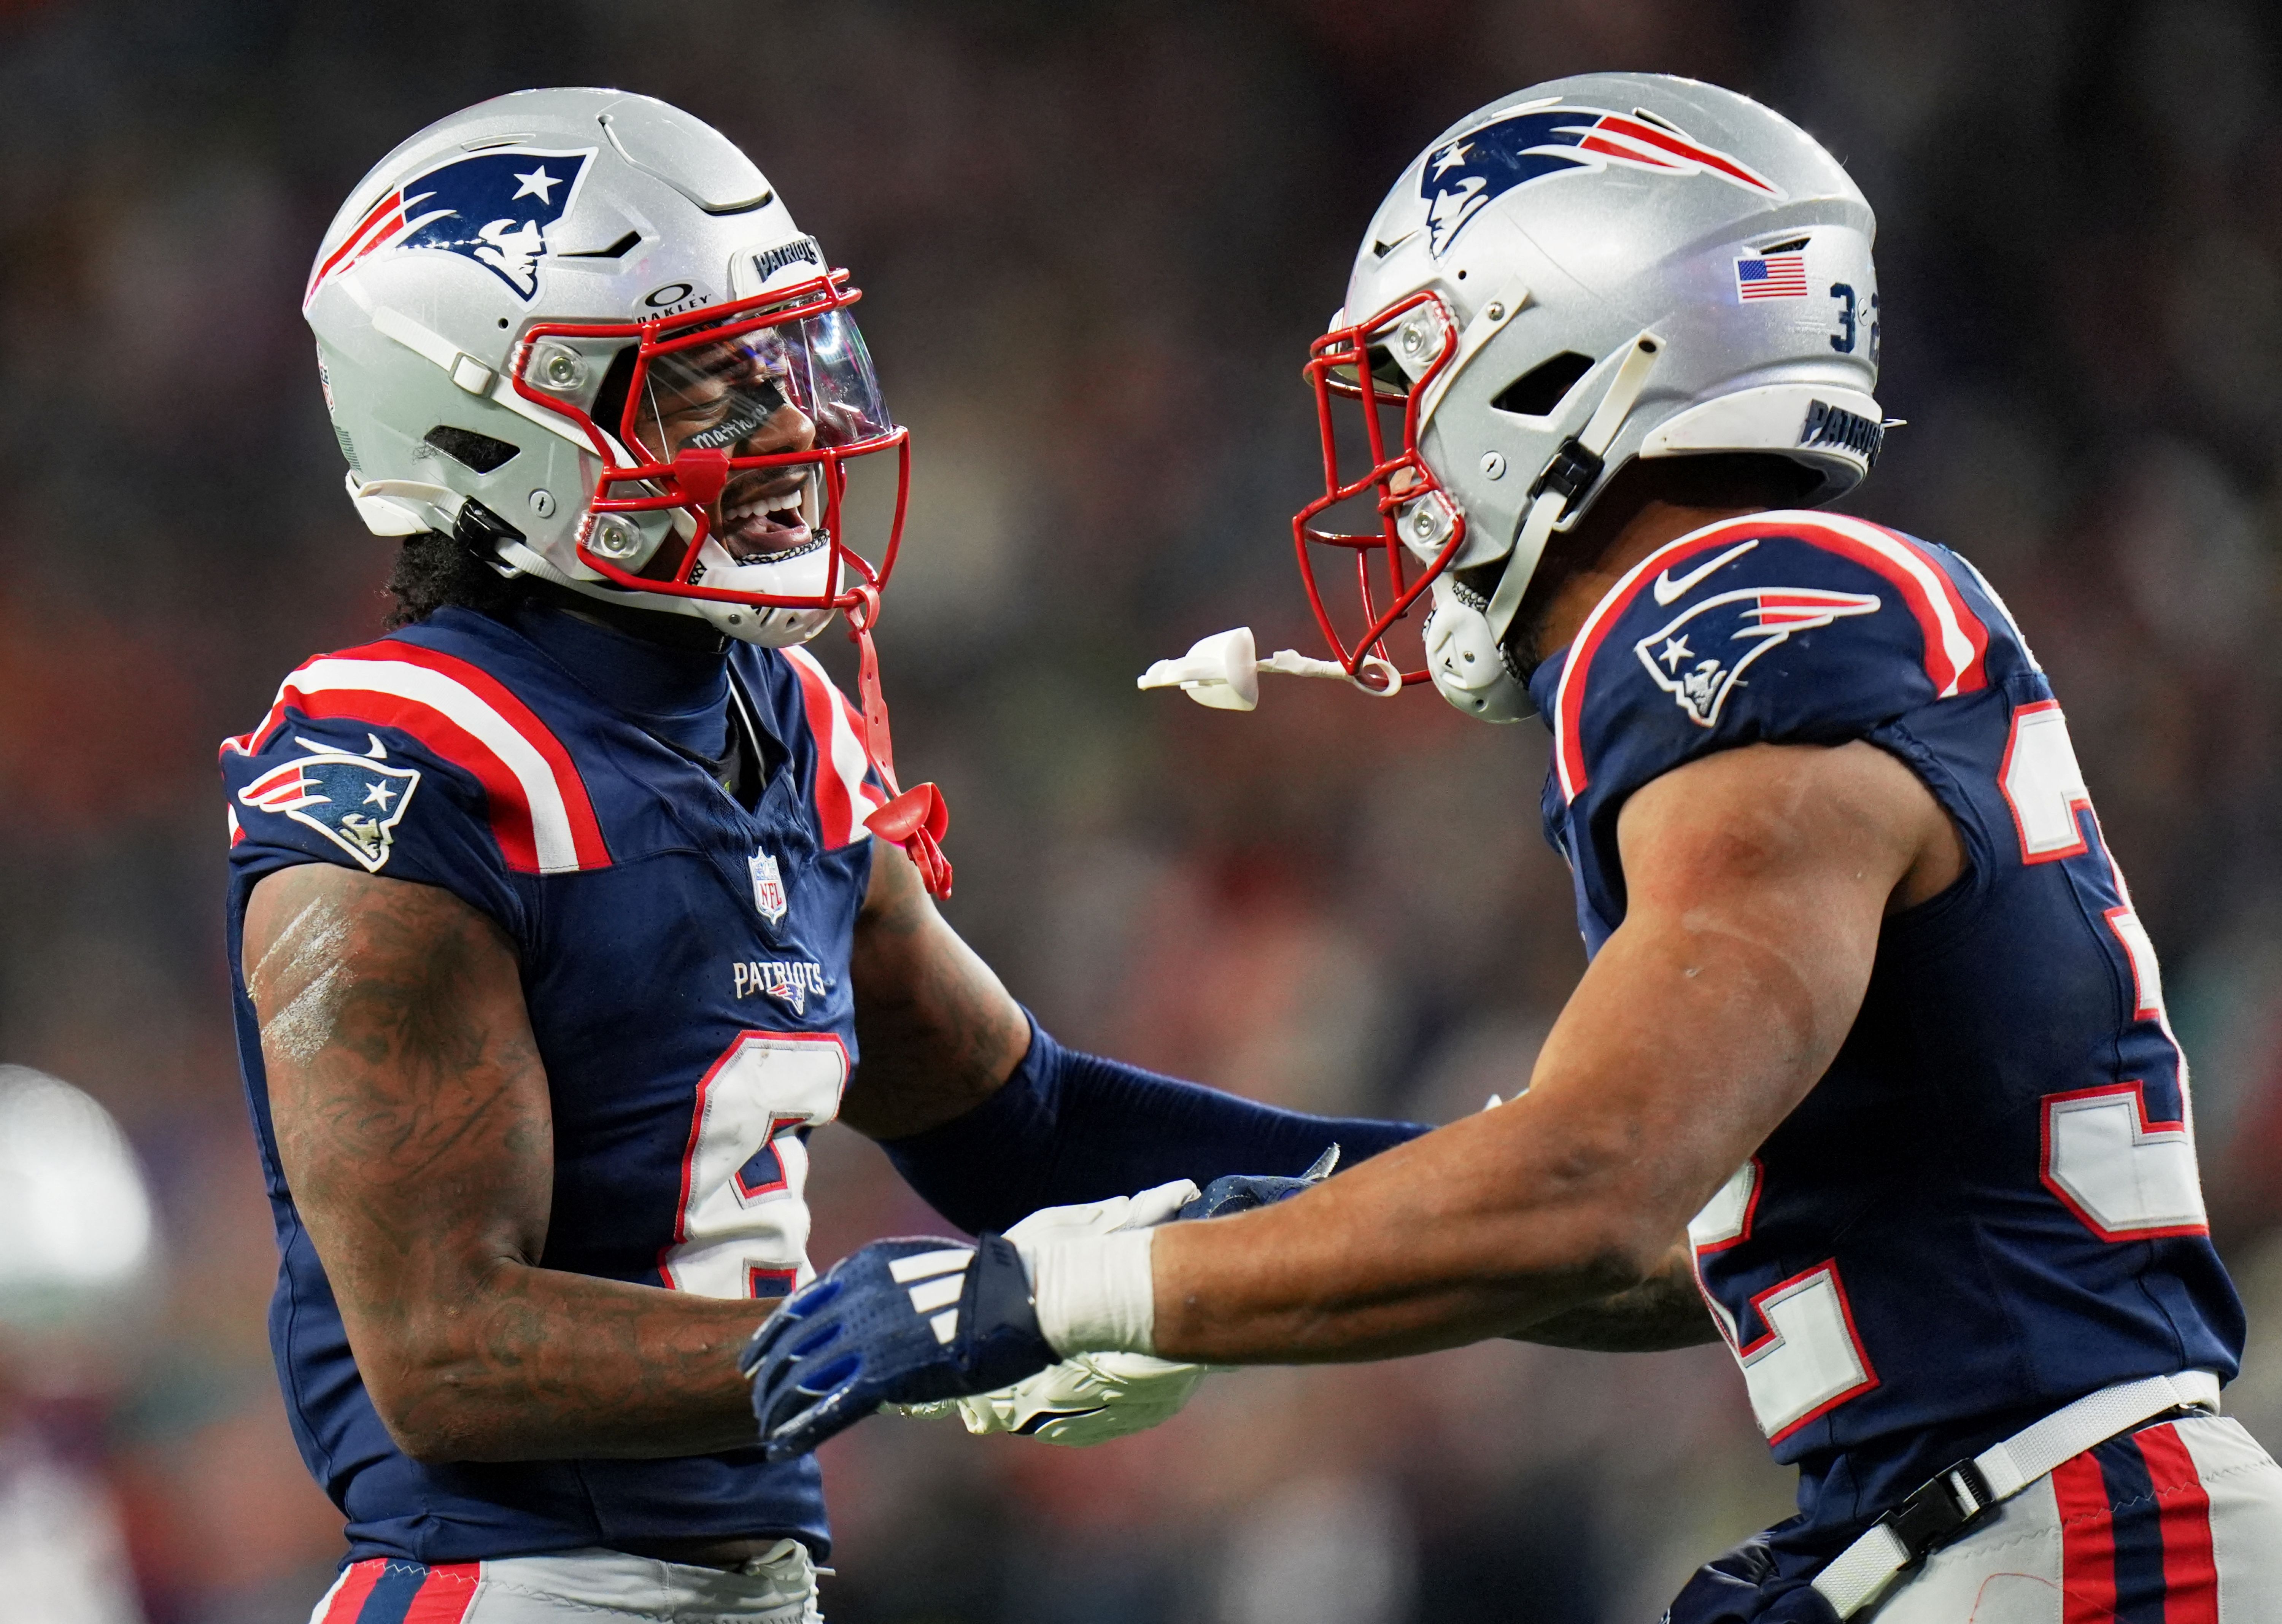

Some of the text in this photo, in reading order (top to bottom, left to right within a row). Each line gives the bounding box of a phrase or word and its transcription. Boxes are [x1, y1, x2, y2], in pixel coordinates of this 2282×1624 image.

[752, 239, 818, 283] PATRIOTS
[760, 883, 782, 910] NFL
[733, 961, 826, 999] PATRIOTS
